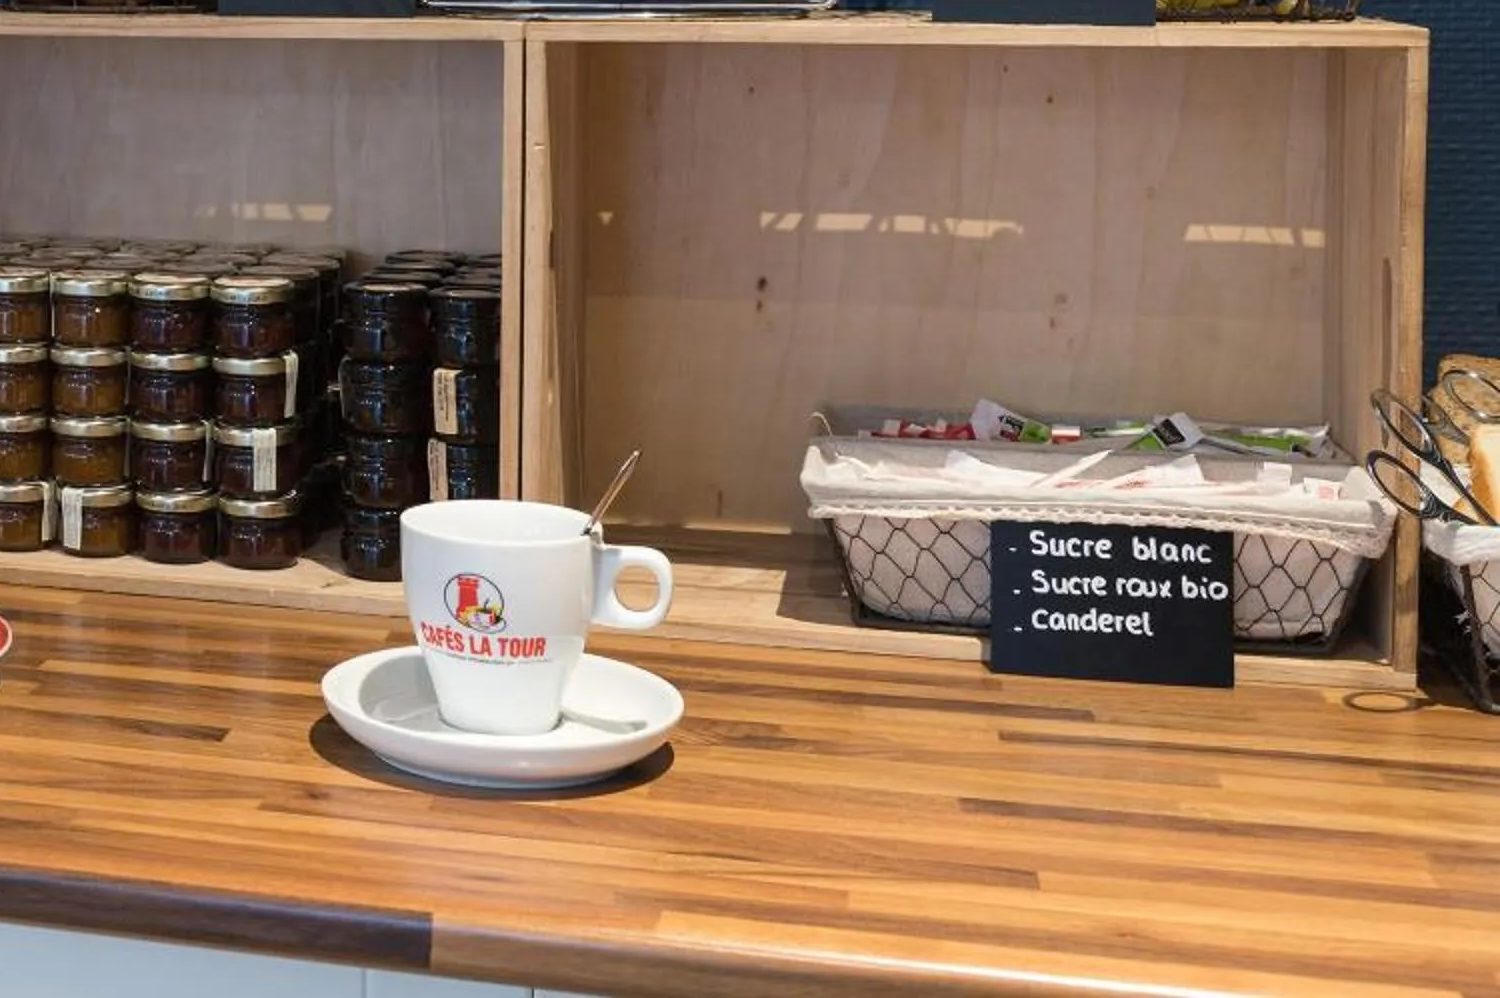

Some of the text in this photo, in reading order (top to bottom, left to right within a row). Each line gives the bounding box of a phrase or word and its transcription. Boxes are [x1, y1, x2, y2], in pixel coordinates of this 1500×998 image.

[1029, 529, 1213, 563] Sucre blanc
[1031, 569, 1229, 600] Sucre roux bio
[469, 634, 493, 657] LA
[497, 636, 547, 659] TOUR
